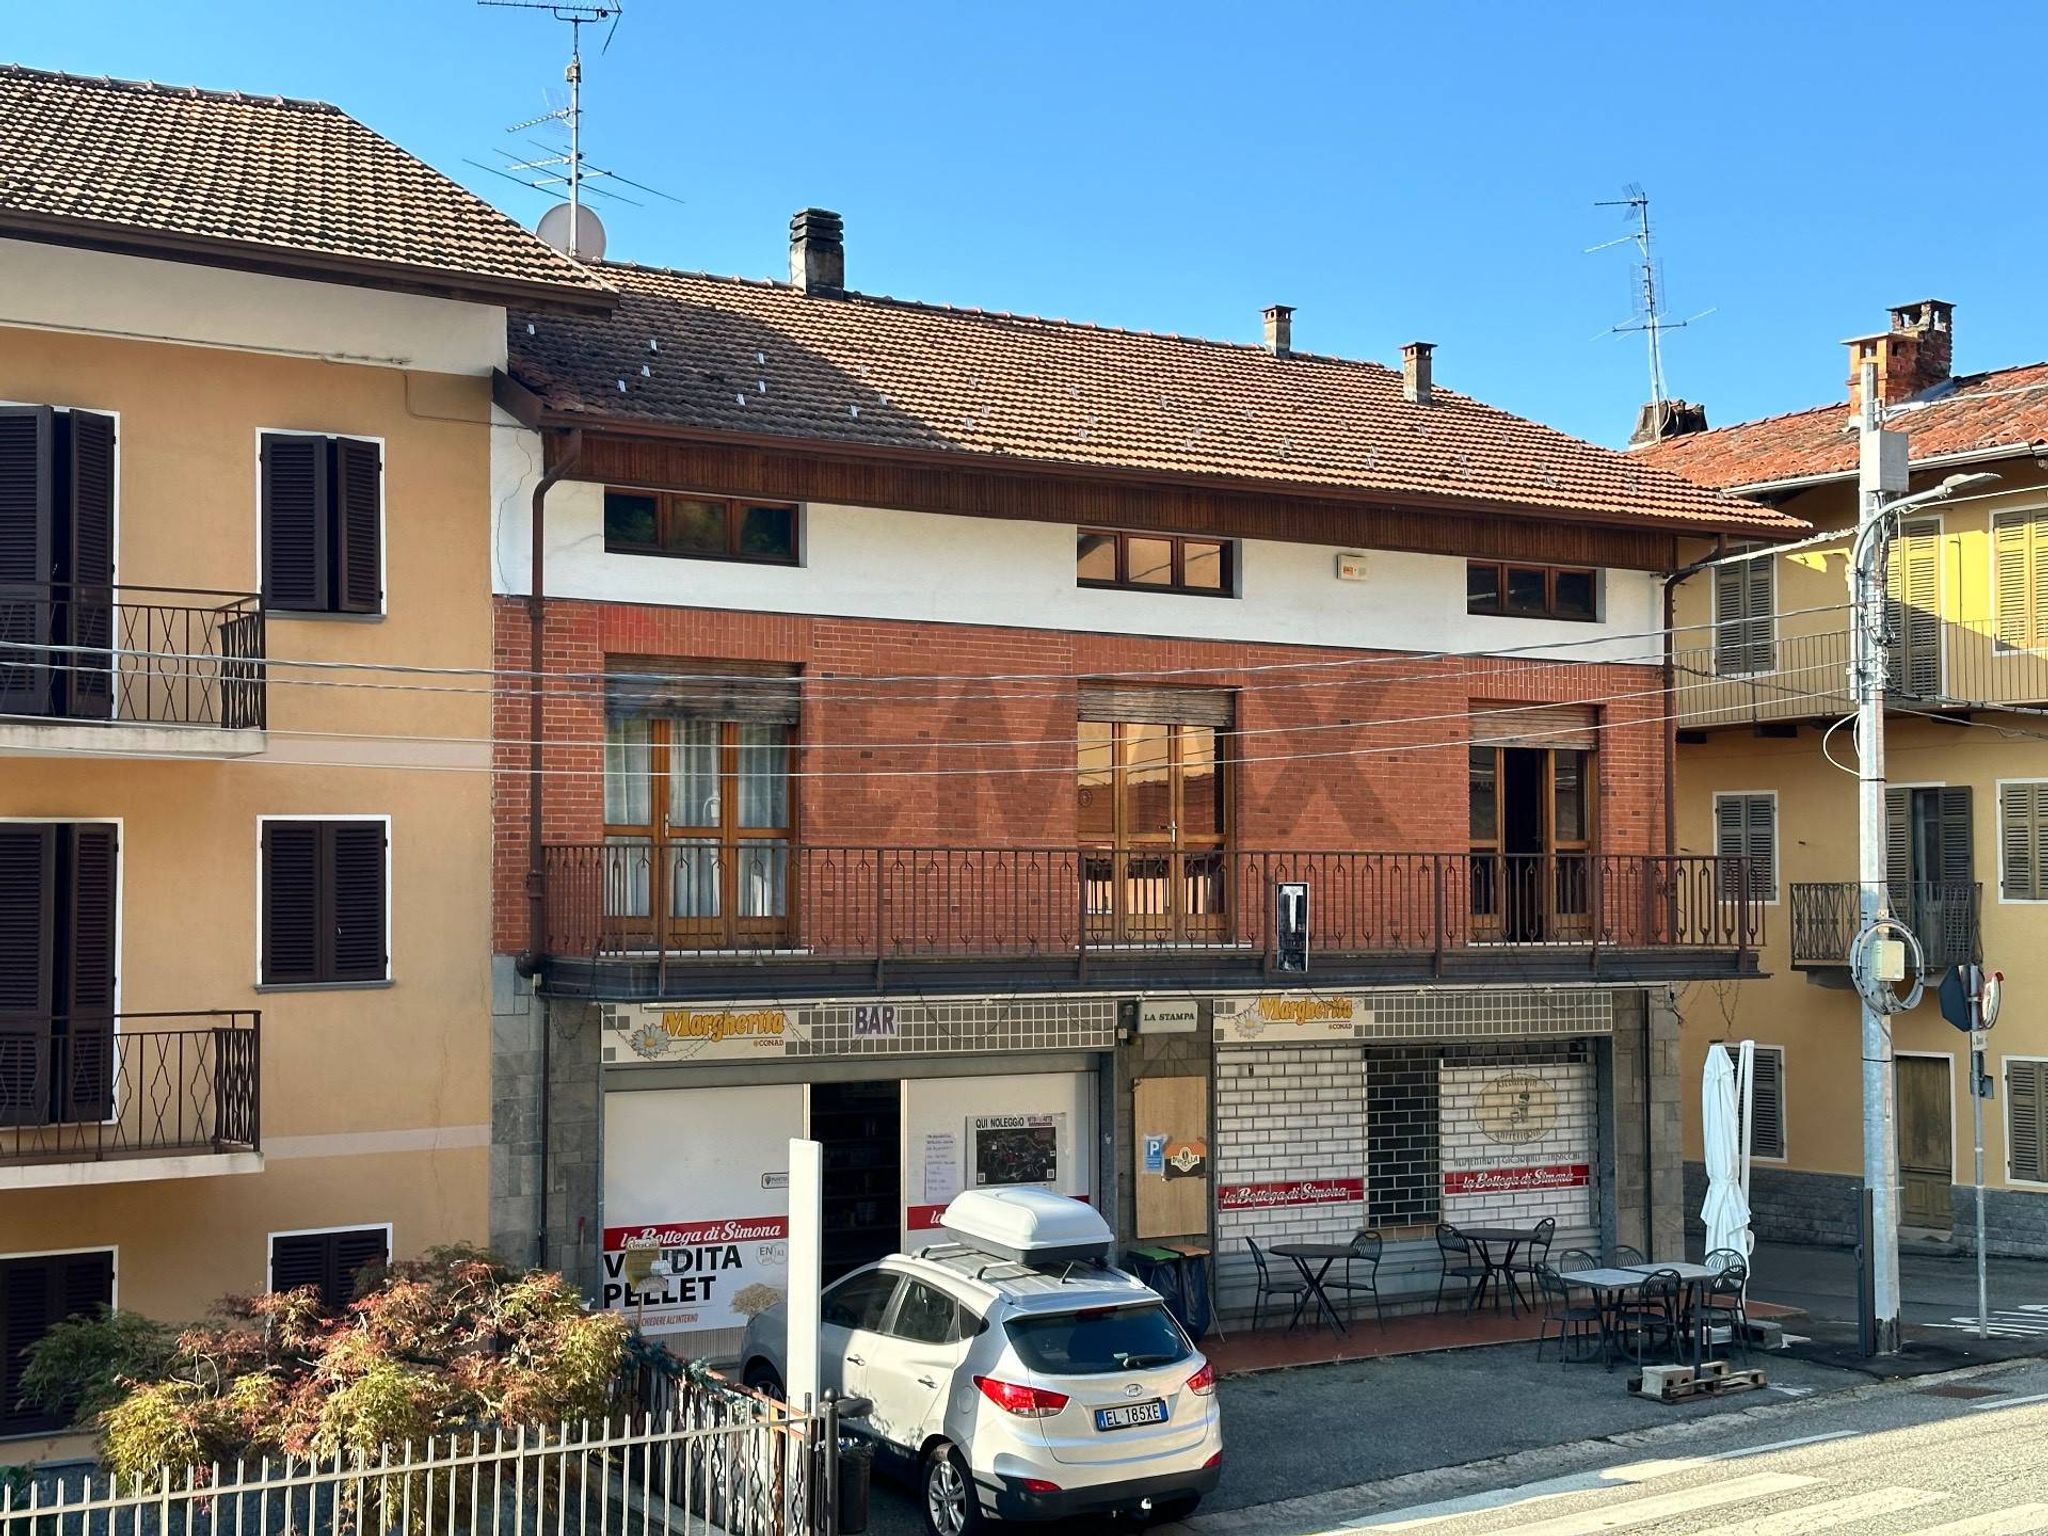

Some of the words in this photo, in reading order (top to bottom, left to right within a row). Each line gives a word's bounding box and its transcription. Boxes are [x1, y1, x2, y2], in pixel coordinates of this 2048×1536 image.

[855, 1006, 895, 1035] BAR
[1144, 1013, 1156, 1021] LA
[1159, 1012, 1195, 1021] STAMPA
[1259, 996, 1353, 1025] Margherita
[662, 1009, 785, 1042] Margherita
[976, 1118, 988, 1129] QUI
[990, 1116, 1025, 1128] NOLEGGIO
[1150, 1141, 1160, 1156] P
[1463, 1176, 1475, 1189] la
[1476, 1172, 1519, 1190] Bottega
[1519, 1172, 1533, 1186] di
[1533, 1169, 1574, 1185] Simona
[1223, 1191, 1236, 1204] la
[1237, 1187, 1285, 1205] Bottega
[1286, 1187, 1300, 1200] di
[1300, 1182, 1347, 1200] Simona
[640, 1227, 702, 1246] Bottega
[703, 1226, 720, 1241] di
[721, 1221, 781, 1241] Simona
[604, 1245, 743, 1278] VDITA
[760, 1247, 773, 1256] EN
[1105, 1410, 1122, 1426] EL
[1125, 1404, 1160, 1423] 185XE
